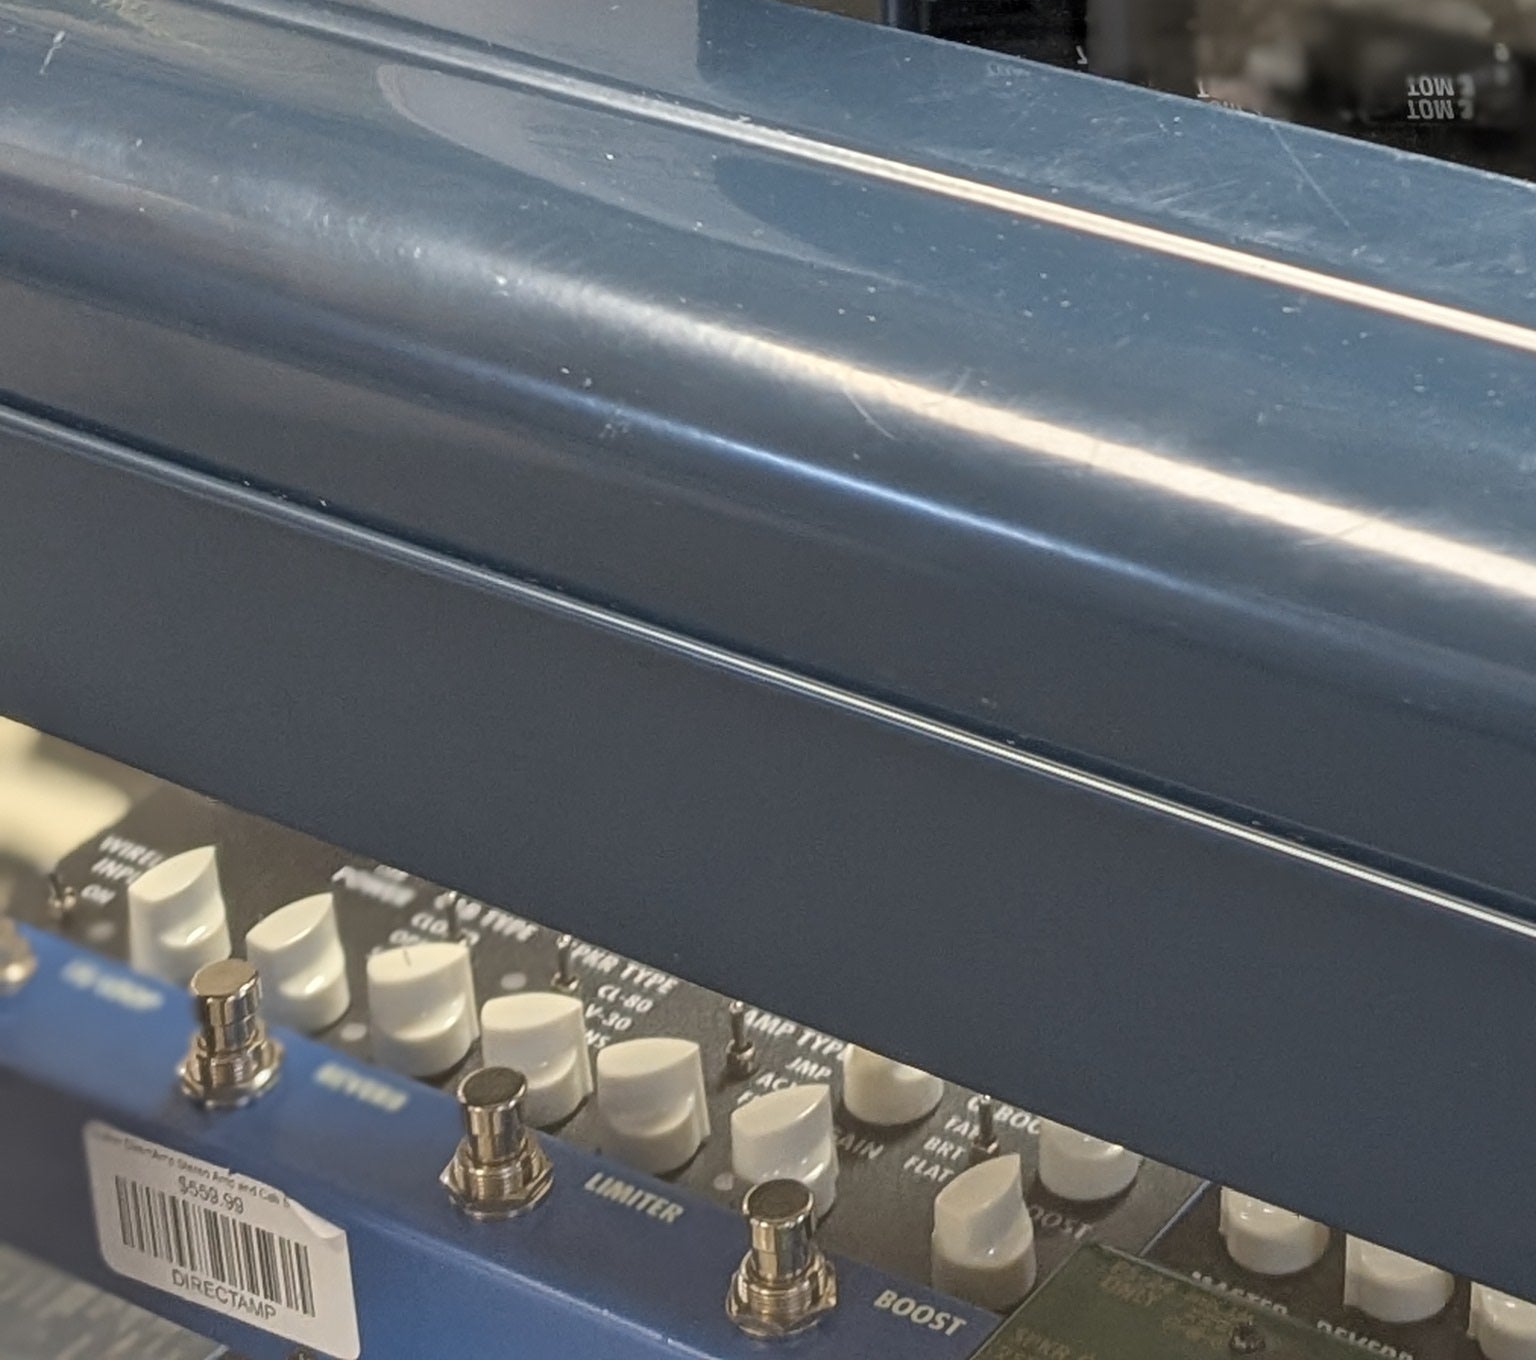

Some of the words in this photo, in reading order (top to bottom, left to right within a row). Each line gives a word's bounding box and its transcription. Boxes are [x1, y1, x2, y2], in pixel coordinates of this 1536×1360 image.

[620, 964, 679, 995] TYPE
[744, 1008, 796, 1036] AMP
[923, 1136, 966, 1160] BRT
[904, 1155, 954, 1182] FLAT
[584, 1172, 684, 1223] LIMITER
[172, 1269, 276, 1321] DIRECTAMP
[873, 1289, 967, 1336] BOOST
